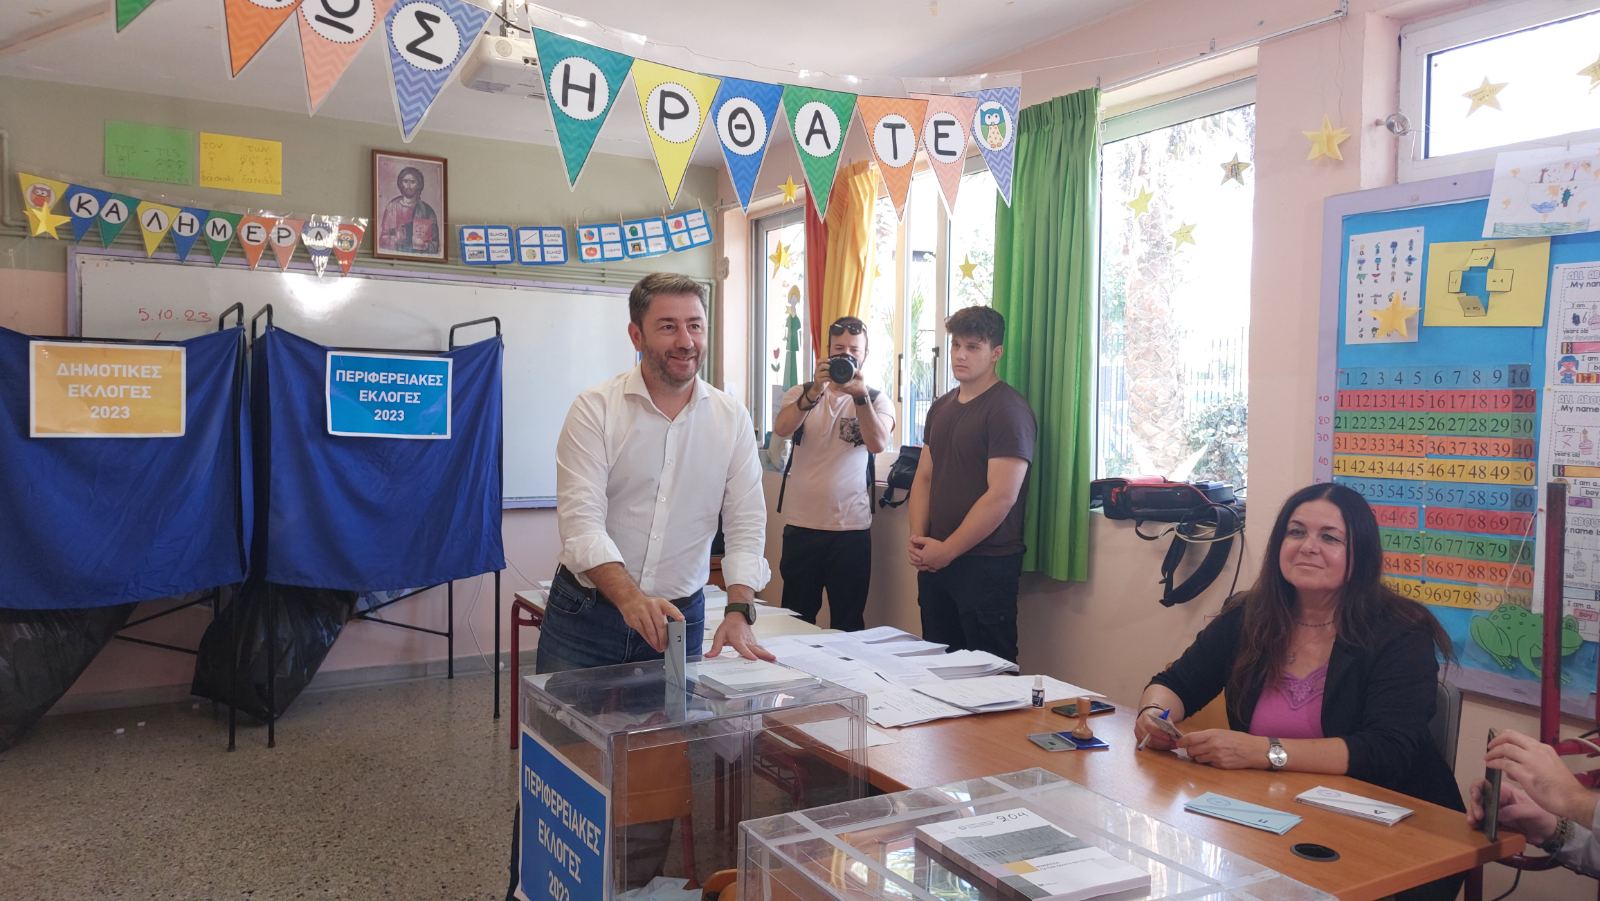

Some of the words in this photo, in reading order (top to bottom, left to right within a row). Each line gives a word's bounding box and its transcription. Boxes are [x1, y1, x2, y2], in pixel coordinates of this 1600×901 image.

[560, 63, 957, 162] ΗΡΘΑΤΕ
[56, 363, 162, 379] ΔΗΜΟΤΙΚΕΣ
[336, 370, 444, 386] ΠΕΡΙΦΕΡΕΙΑΚΕΣ
[1346, 373, 1350, 385] 1
[1360, 372, 1368, 385] 2
[1377, 372, 1384, 384] 3
[1394, 372, 1403, 384] 4
[1414, 371, 1421, 384] 5
[1434, 371, 1442, 384] 6
[1454, 370, 1461, 384] 7
[1472, 370, 1480, 384] 8
[1493, 370, 1502, 384] 9
[1511, 369, 1529, 384] 10
[67, 384, 152, 399] ΕΚΛΟΓΕΣ
[359, 390, 421, 404] ΕΚΛΟΓΕΣ
[1340, 395, 1351, 407] 11
[1357, 395, 1370, 407] 12
[1373, 395, 1387, 407] 13
[1391, 395, 1406, 407] 14
[1410, 395, 1424, 408] 15
[1430, 395, 1445, 408] 16
[1451, 395, 1466, 408] 17
[1472, 395, 1487, 408] 18
[1494, 395, 1510, 408] 19
[1514, 394, 1534, 408] 20
[90, 406, 130, 419] 2023
[374, 409, 405, 422] 2023
[1335, 416, 1347, 429] 21
[1352, 417, 1366, 429] 22
[1370, 417, 1385, 429] 23
[1389, 417, 1405, 430] 24
[1408, 417, 1424, 430] 25
[1427, 417, 1444, 430] 26
[1448, 418, 1465, 431] 27
[1469, 418, 1486, 432] 28
[1490, 418, 1509, 432] 29
[1513, 418, 1533, 433] 30
[1335, 437, 1347, 449] 31
[1352, 437, 1366, 450] 32
[1370, 438, 1385, 451] 33
[1388, 439, 1404, 452] 34
[1408, 440, 1423, 453] 35
[1429, 441, 1445, 455] 36
[1449, 442, 1466, 455] 37
[1470, 442, 1488, 456] 38
[1492, 443, 1510, 457] 39
[1334, 460, 1346, 472] 41
[1351, 460, 1365, 473] 42
[1368, 461, 1383, 474] 43
[1387, 462, 1404, 475] 44
[1407, 462, 1423, 476] 45
[1427, 464, 1444, 477] 46
[1447, 464, 1465, 478] 47
[1469, 465, 1486, 479] 48
[1490, 466, 1509, 479] 49
[1369, 484, 1383, 497] 53
[1388, 485, 1404, 499] 54
[1408, 486, 1423, 500] 55
[1427, 488, 1443, 501] 56
[1446, 490, 1464, 502] 57
[1468, 490, 1486, 505] 58
[1490, 492, 1509, 506] 59
[1515, 492, 1533, 507] 60
[1400, 512, 1416, 525] 65
[1427, 512, 1443, 526] 66
[1447, 514, 1463, 527] 67
[1468, 514, 1486, 529] 68
[1490, 516, 1509, 530] 69
[1384, 535, 1400, 548] 74
[1404, 536, 1420, 549] 75
[1425, 538, 1442, 552] 76
[1446, 540, 1463, 555] 77
[1467, 541, 1485, 557] 78
[1488, 543, 1507, 558] 79
[1384, 558, 1400, 571] 84
[1404, 559, 1420, 572] 85
[1426, 561, 1443, 574] 86
[1447, 563, 1463, 577] 87
[1467, 565, 1485, 579] 88
[1490, 567, 1508, 582] 89
[1404, 584, 1421, 599] 95
[1424, 587, 1441, 602] 96
[1444, 589, 1460, 603] 97
[1463, 590, 1480, 604] 98
[524, 765, 601, 856] ΠΕΡΙΦΕΡΕΙΑΚΕΣ
[538, 818, 582, 884] ΕΚΛΟΓΕΣ
